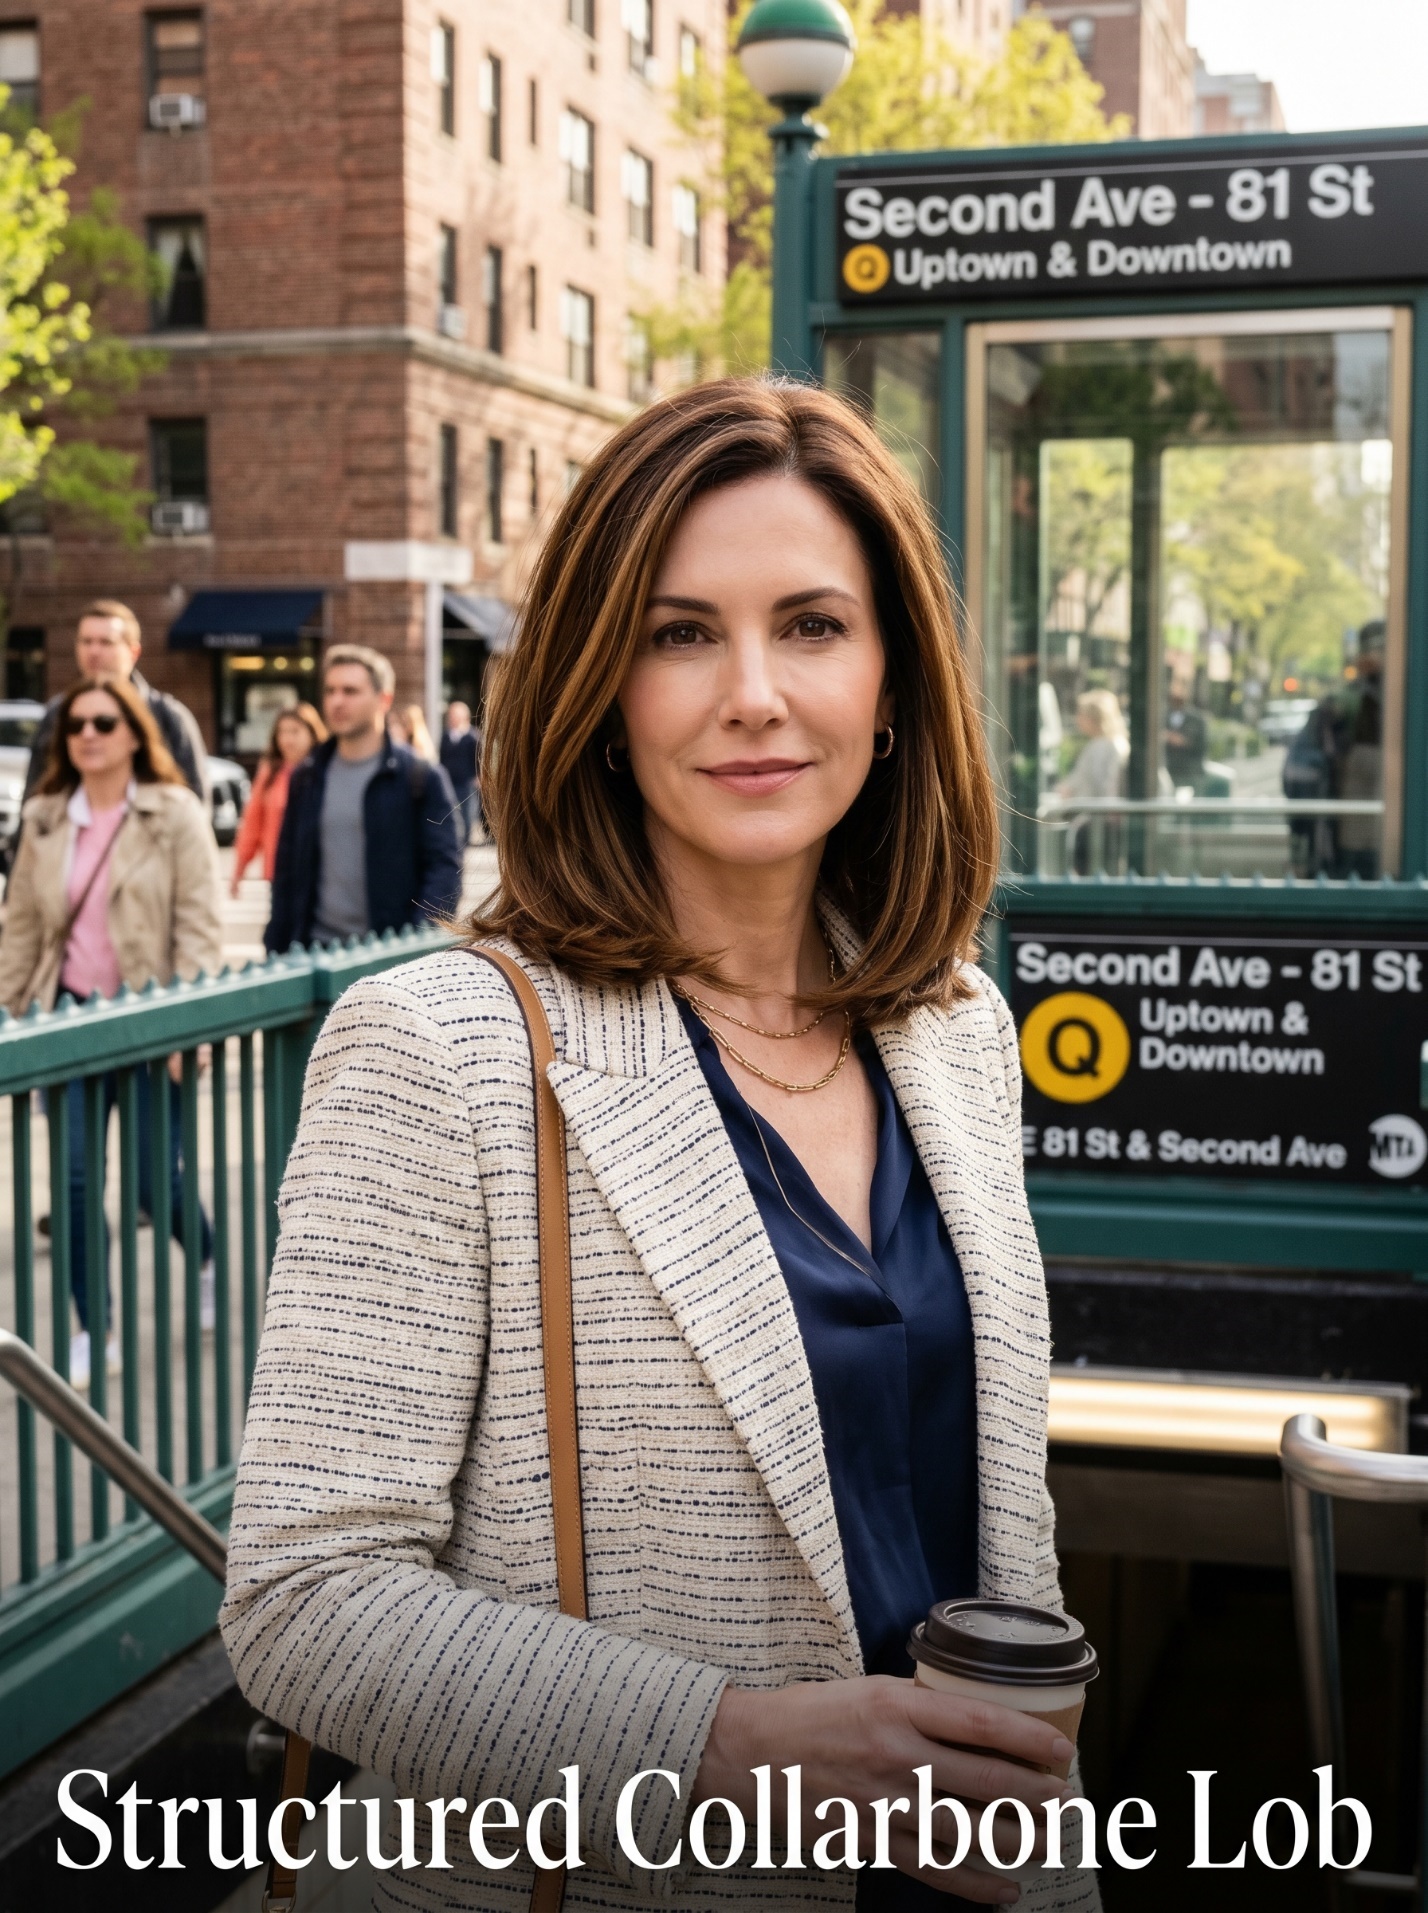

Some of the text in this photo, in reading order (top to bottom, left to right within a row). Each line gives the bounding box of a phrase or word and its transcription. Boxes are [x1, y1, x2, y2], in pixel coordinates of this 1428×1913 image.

[843, 163, 1376, 241] Second Ave - 81 St
[893, 248, 1038, 290] Uptown
[1046, 240, 1078, 278] &
[1087, 236, 1292, 277] Downtown
[1016, 942, 1423, 992] Second Ave - 81 St
[1139, 998, 1309, 1037] Uptown &
[1047, 1016, 1100, 1079] Q
[1139, 1036, 1325, 1074] Downtown
[1042, 1126, 1080, 1158] 81
[1084, 1127, 1121, 1159] St
[1126, 1130, 1151, 1160] &
[1158, 1130, 1281, 1166] Second
[1287, 1136, 1348, 1169] Ave
